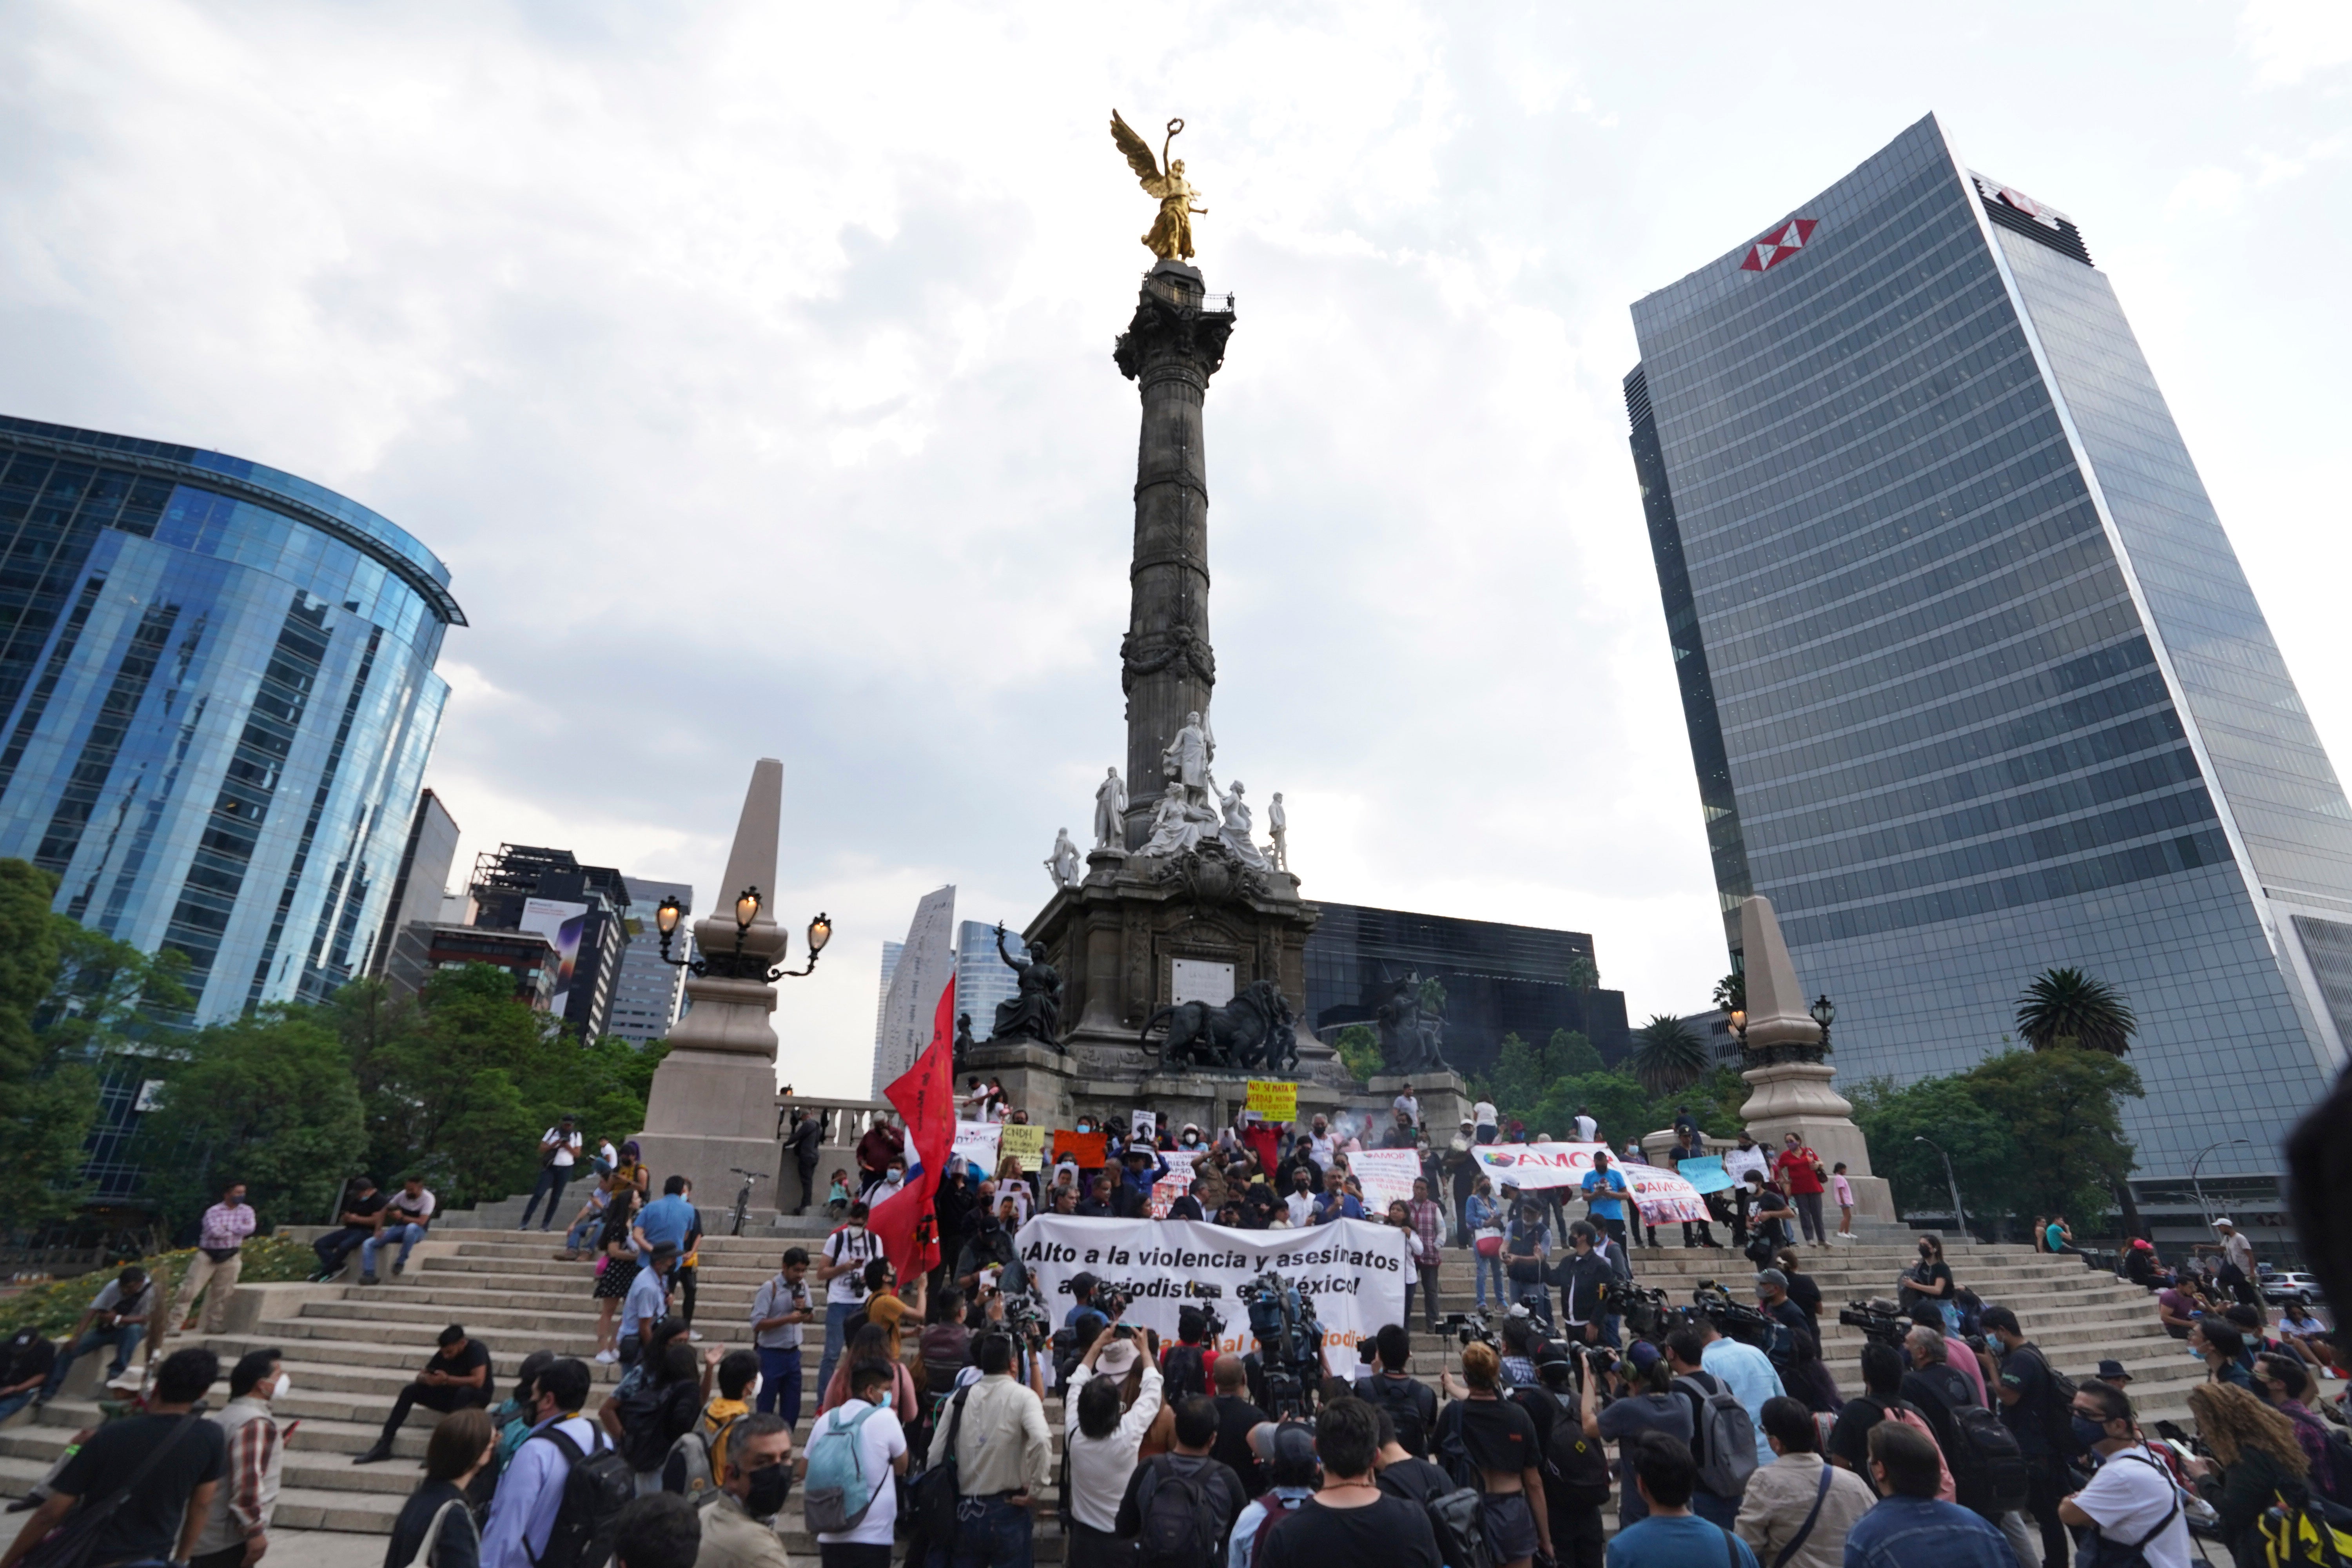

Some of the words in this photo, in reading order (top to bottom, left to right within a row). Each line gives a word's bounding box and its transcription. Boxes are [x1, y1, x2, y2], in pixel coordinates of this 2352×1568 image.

[1249, 1082, 1260, 1091] NO
[1272, 1084, 1289, 1093] MATA
[1247, 1094, 1272, 1103] VERDAD
[1005, 1127, 1033, 1140] CNDH
[956, 1136, 995, 1144] OTIMEX
[1373, 1152, 1405, 1160] AMOR
[1647, 1181, 1691, 1193] AMOR
[1022, 1241, 1076, 1262] ¡Alto
[1085, 1249, 1099, 1263] a
[1107, 1246, 1130, 1265] la
[1139, 1247, 1247, 1268] violencia
[1253, 1254, 1269, 1272] y
[1276, 1245, 1399, 1272] asesinatos
[1285, 1274, 1360, 1296] éxico!
